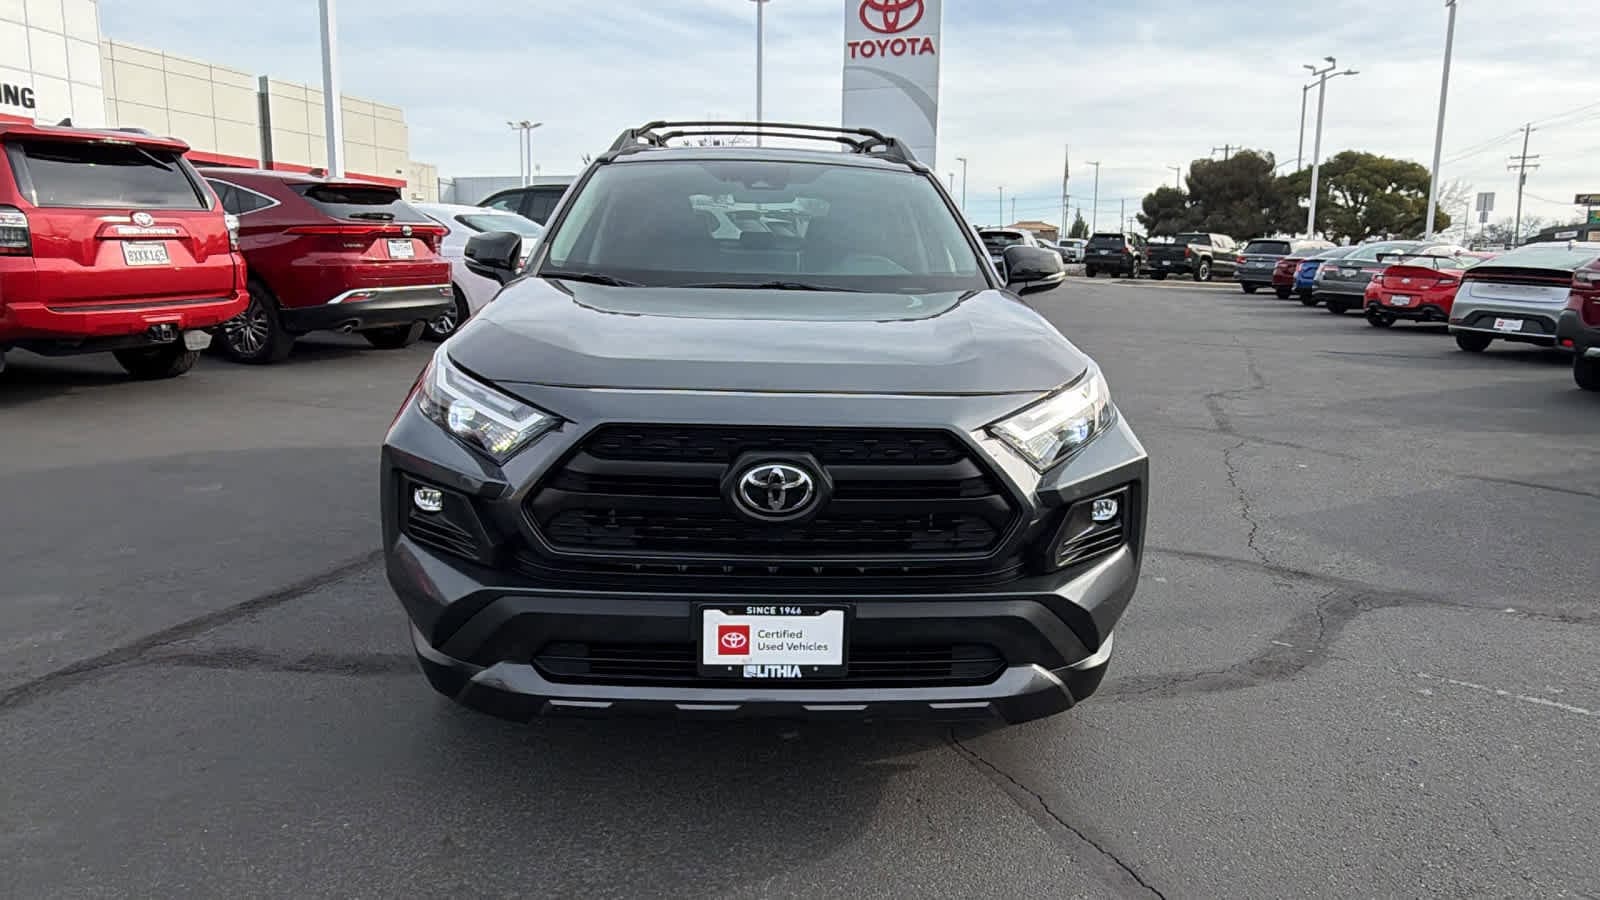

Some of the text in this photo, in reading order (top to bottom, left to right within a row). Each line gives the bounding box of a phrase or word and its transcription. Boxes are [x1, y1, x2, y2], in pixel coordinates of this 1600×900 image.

[847, 37, 935, 59] TOYOTA
[746, 606, 802, 615] SINCE 1946
[757, 629, 803, 639] Certified
[757, 642, 828, 651] Used Vehicles
[757, 664, 802, 678] LITHIA
